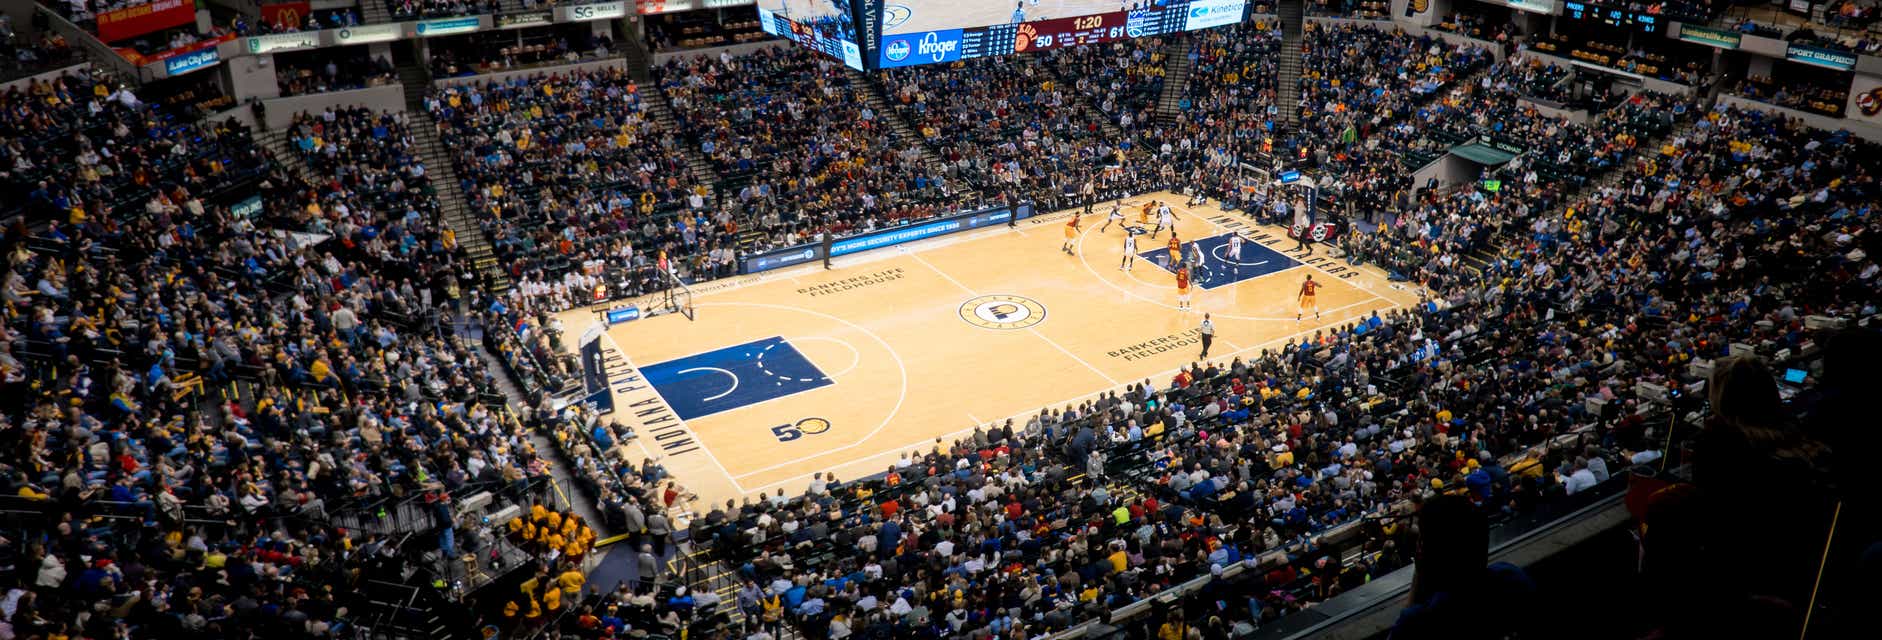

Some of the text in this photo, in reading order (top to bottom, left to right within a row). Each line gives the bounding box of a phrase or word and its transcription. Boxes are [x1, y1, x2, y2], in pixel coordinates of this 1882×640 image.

[575, 7, 593, 18] SG
[1211, 4, 1243, 14] Kinetico
[865, 10, 876, 51] Vincent
[1074, 15, 1102, 30] 1:20
[1110, 26, 1124, 38] 61
[919, 32, 957, 62] Kroger
[1036, 35, 1053, 48] 50
[1788, 47, 1856, 66] SPORT GRAPHICS
[867, 235, 898, 247] SECURITY
[899, 229, 926, 240] EXPERTS
[797, 267, 905, 294] BANKERS LIFE
[810, 273, 905, 297] FIELDHOUSE
[1107, 334, 1179, 359] BANKERS
[1124, 337, 1199, 362] FIELDHOU
[629, 396, 700, 457] INDIANA
